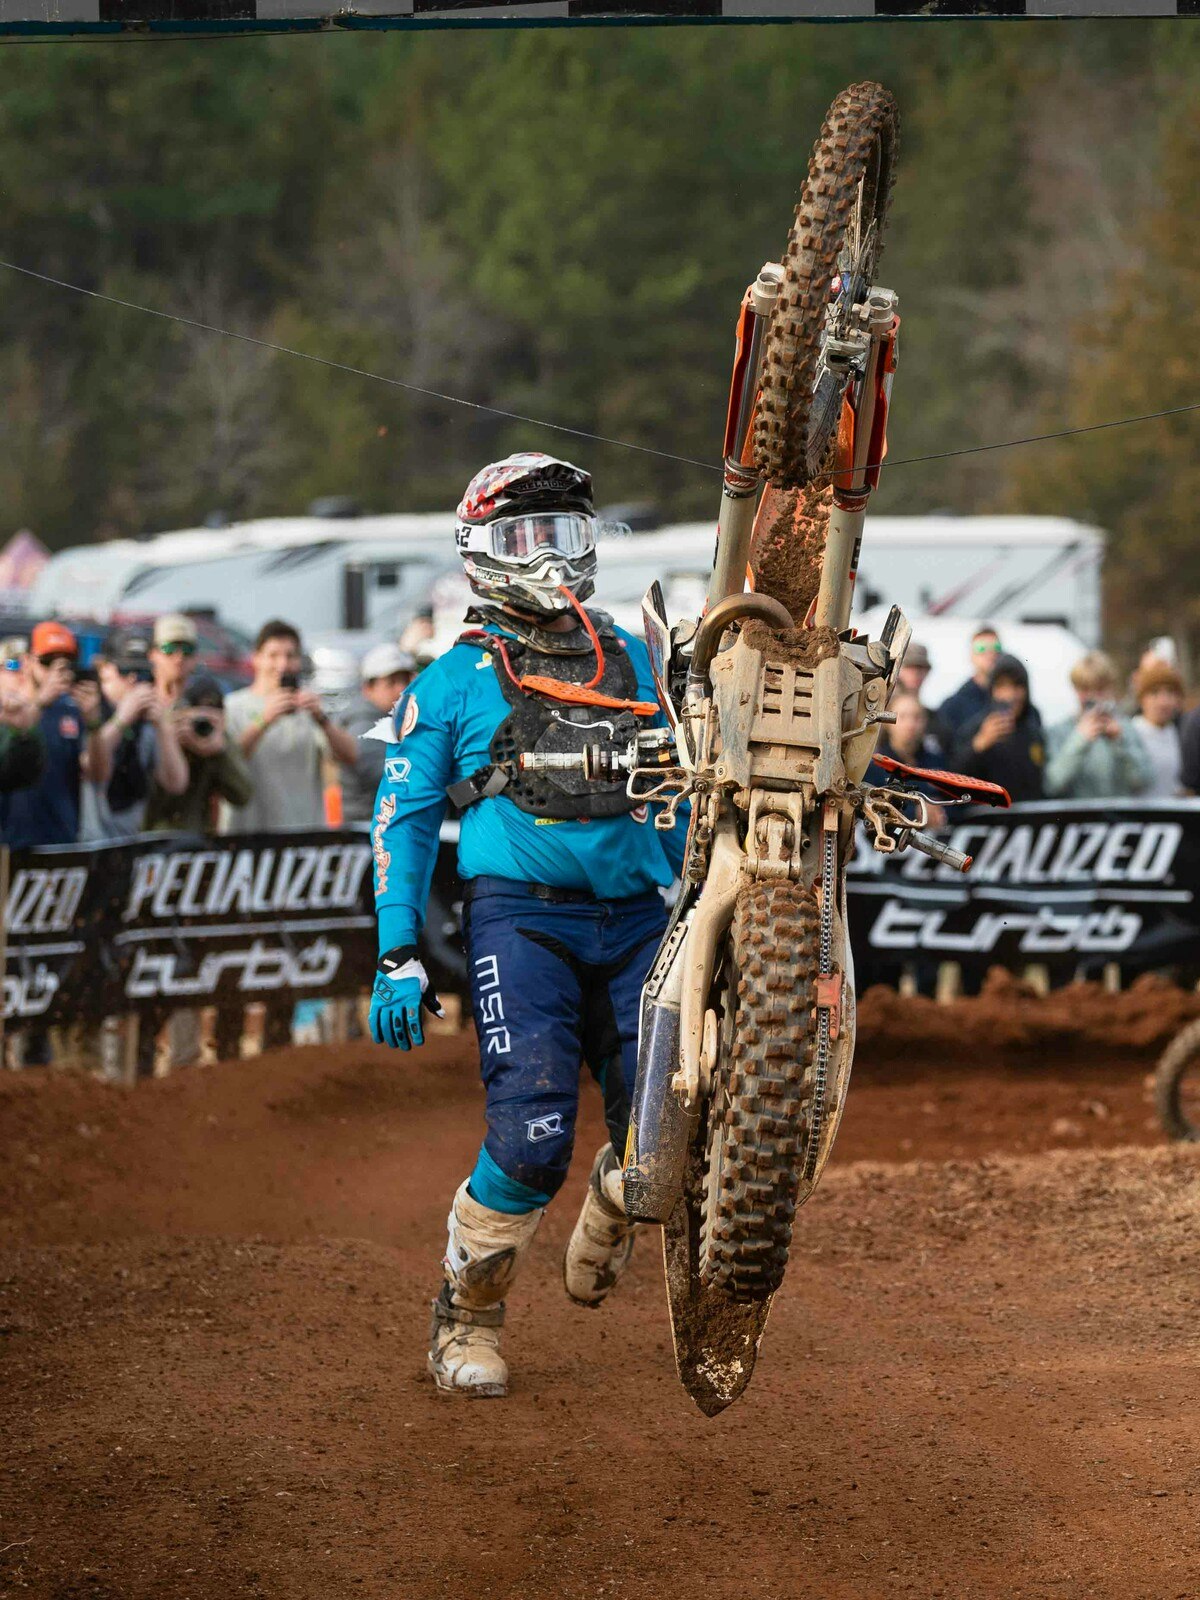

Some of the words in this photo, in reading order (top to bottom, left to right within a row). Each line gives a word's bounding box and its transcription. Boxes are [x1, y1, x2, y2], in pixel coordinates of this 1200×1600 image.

[120, 844, 373, 923] PECIALIZED
[868, 899, 1143, 953] turbo
[125, 933, 343, 999] turbo
[475, 954, 512, 1055] MSR
